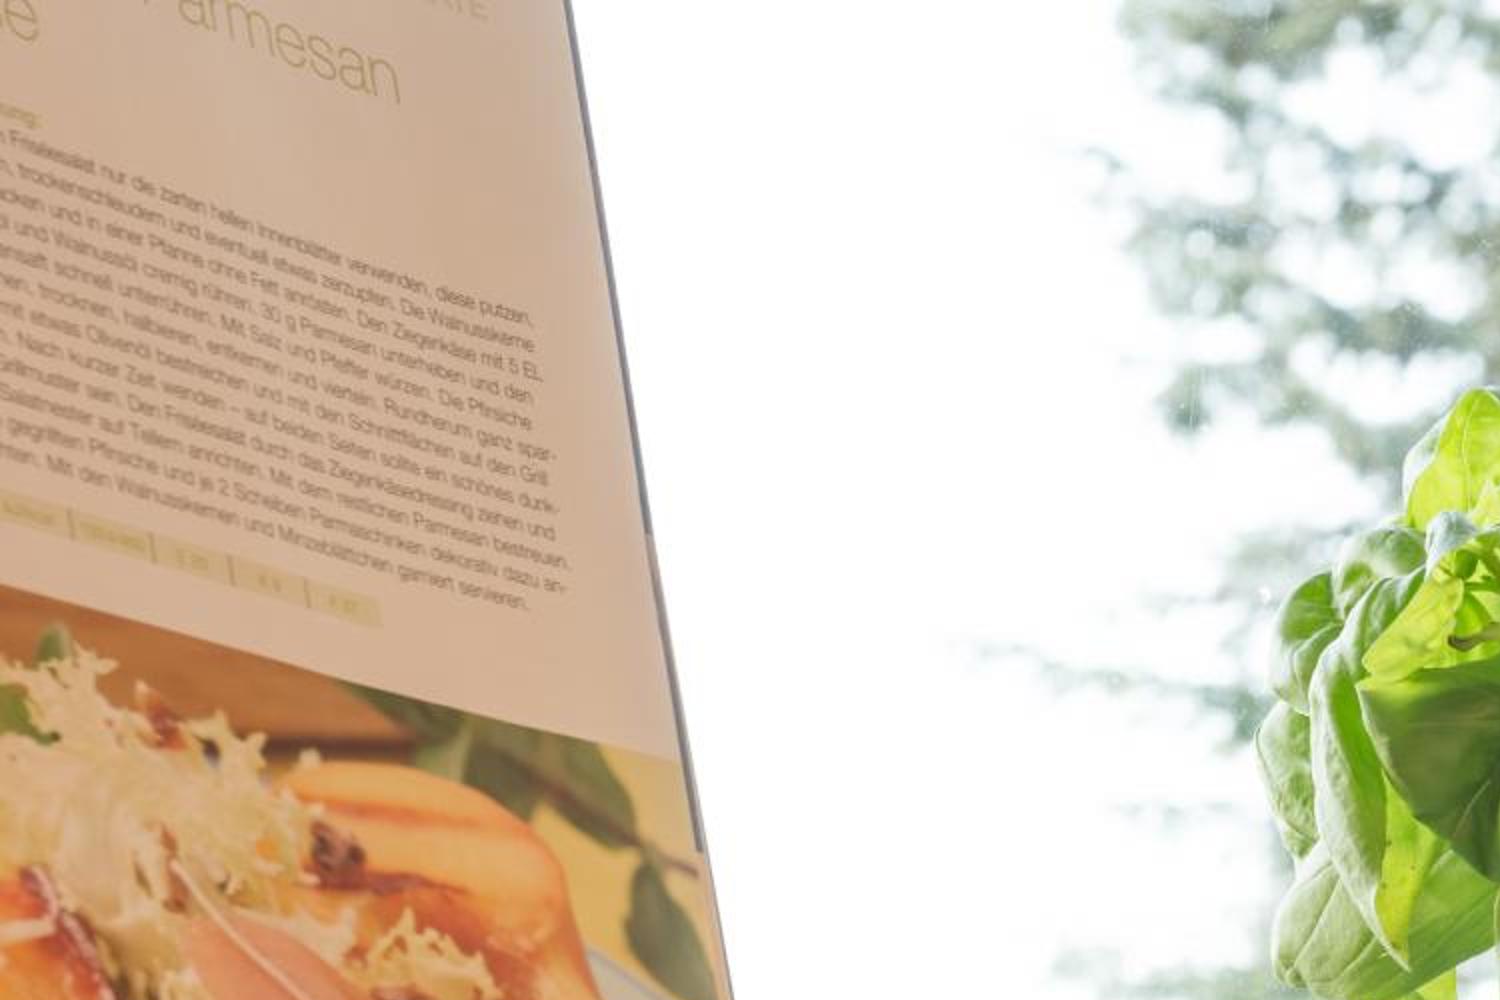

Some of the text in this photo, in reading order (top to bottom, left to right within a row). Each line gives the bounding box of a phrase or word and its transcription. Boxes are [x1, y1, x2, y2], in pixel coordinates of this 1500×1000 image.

[143, 0, 400, 105] armesan
[12, 218, 48, 241] und
[470, 375, 500, 394] und
[502, 381, 534, 404] den
[46, 202, 82, 224] und
[208, 259, 247, 284] ohne
[356, 309, 386, 333] Den
[479, 352, 504, 369] mit
[167, 218, 202, 241] und
[398, 297, 426, 320] Die
[124, 363, 158, 389] Zeit
[243, 406, 270, 426] auf
[270, 411, 325, 443] beiden
[219, 312, 248, 337] Mit
[250, 323, 284, 350] Salz
[286, 341, 316, 361] und
[437, 386, 466, 409] Die
[252, 383, 284, 404] und
[312, 399, 344, 424] den
[458, 449, 484, 467] auf
[485, 453, 517, 477] den
[287, 368, 318, 389] und
[383, 396, 474, 438] Rundherum
[476, 428, 513, 449] ganz
[45, 453, 75, 477] Mit
[243, 518, 275, 538] und
[125, 392, 161, 419] Den
[247, 432, 294, 462] durch
[296, 448, 327, 473] das
[527, 523, 557, 542] und
[163, 465, 196, 486] und
[267, 465, 296, 489] Mit
[297, 475, 335, 501] dem
